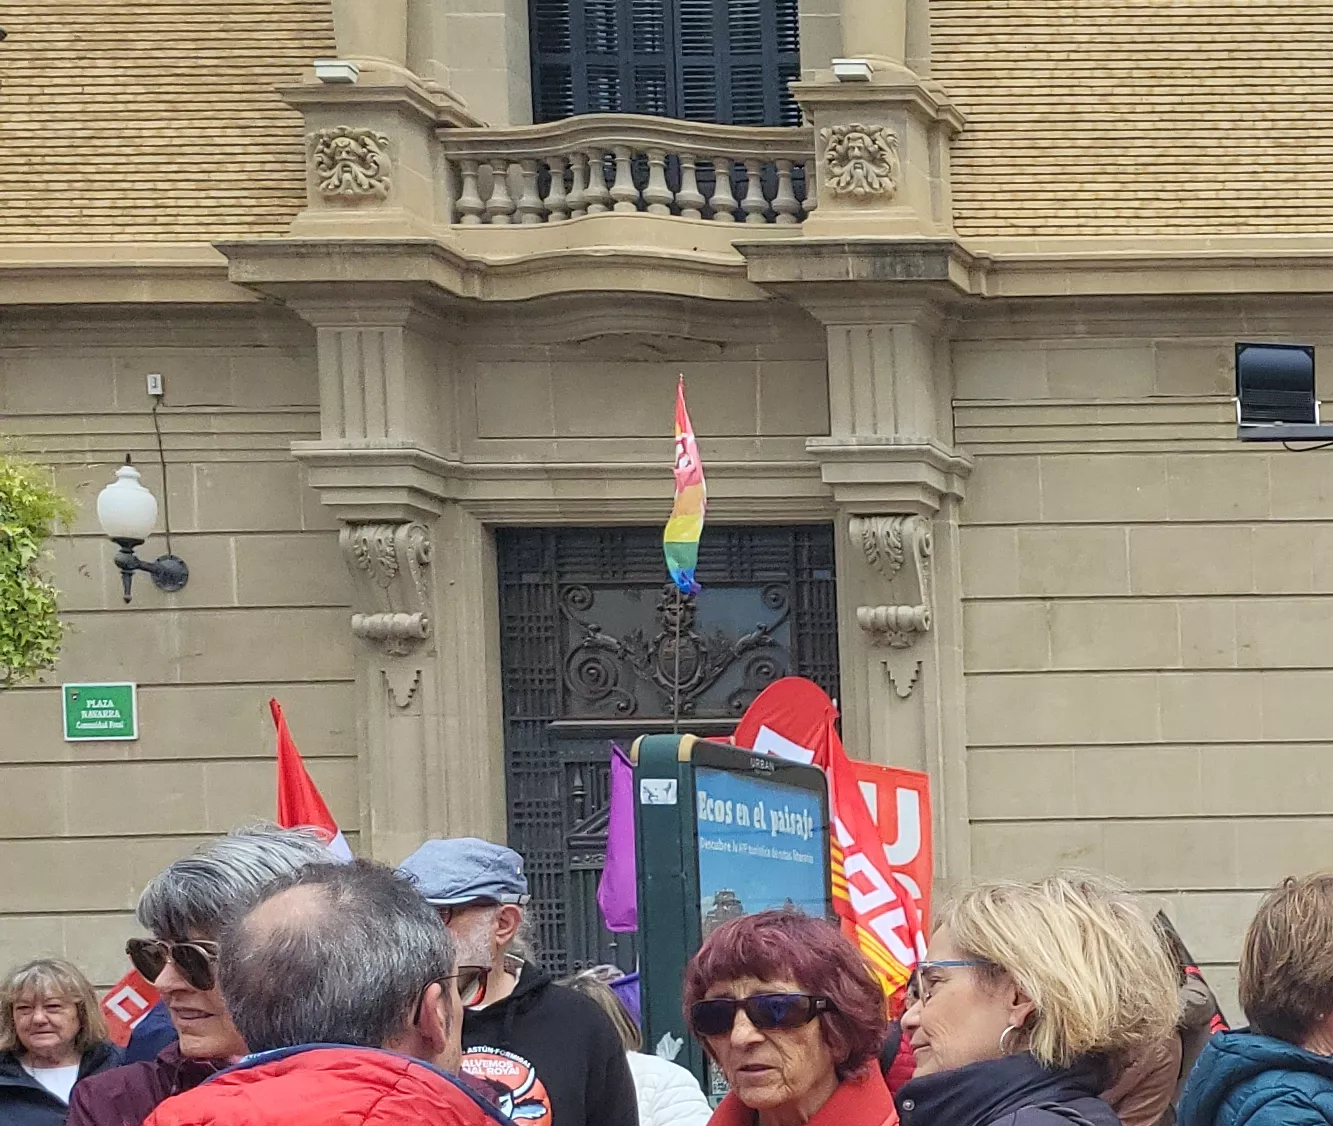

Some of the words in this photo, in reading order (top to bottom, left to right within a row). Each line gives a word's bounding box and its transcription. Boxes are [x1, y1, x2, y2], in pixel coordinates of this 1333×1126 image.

[86, 699, 114, 708] PLAZA
[81, 710, 120, 718] NAVARRA
[697, 791, 732, 824] Ecos
[736, 802, 750, 827] en
[753, 801, 766, 829] el
[770, 805, 813, 840] paisaje
